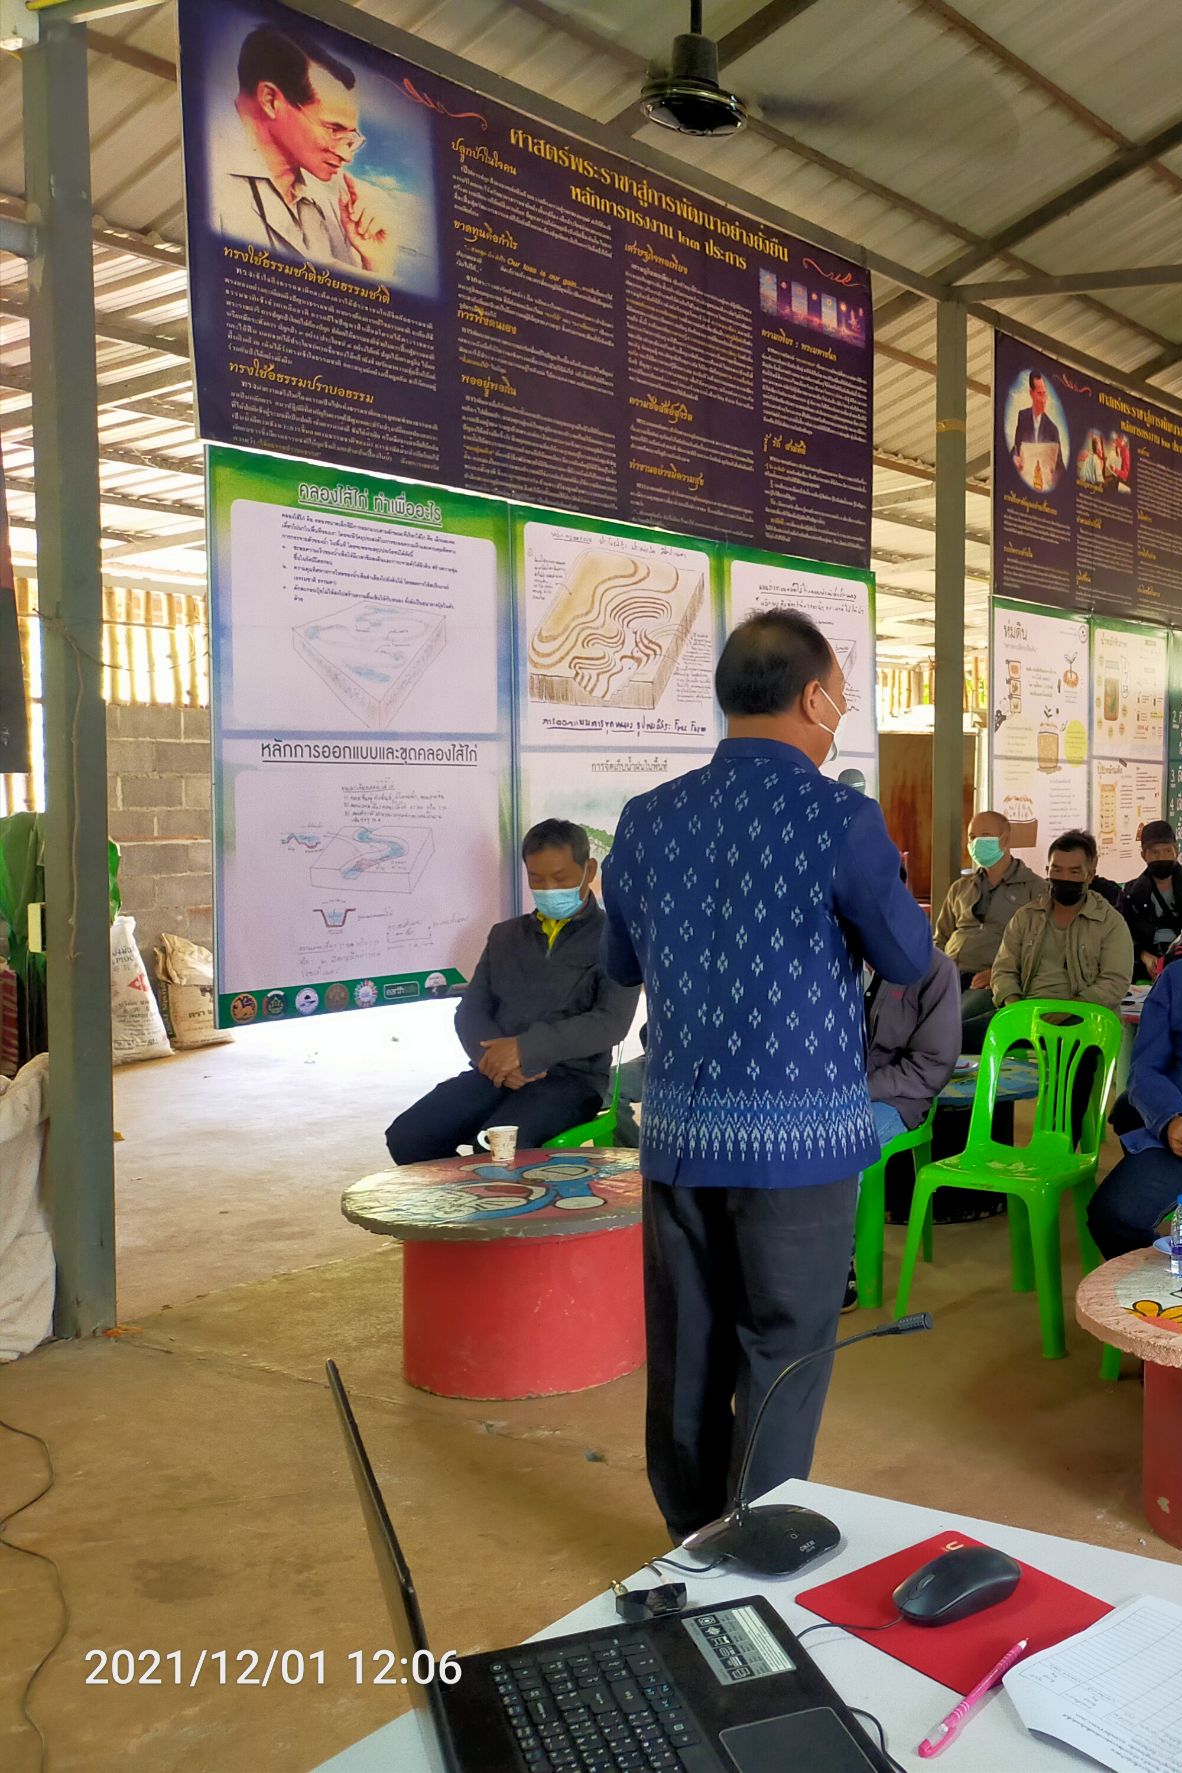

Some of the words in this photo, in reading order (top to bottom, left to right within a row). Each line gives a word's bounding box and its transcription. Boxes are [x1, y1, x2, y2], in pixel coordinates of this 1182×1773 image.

[510, 128, 789, 263] ศาสตร์พระราชาสู่การพัฒนาอย่างยั่งยืน
[570, 185, 674, 240] หลักการทรงงาน
[703, 237, 748, 270] ประการ
[223, 244, 391, 304] ทรงใช้ธรรมชาติช่วยธรรมชาติ
[298, 482, 369, 510] คลองไส้ไก่
[373, 493, 443, 523] ทำเพื่ออะไร
[261, 737, 478, 764] หลักการออกแบบและขุดคลองไส้ไก่
